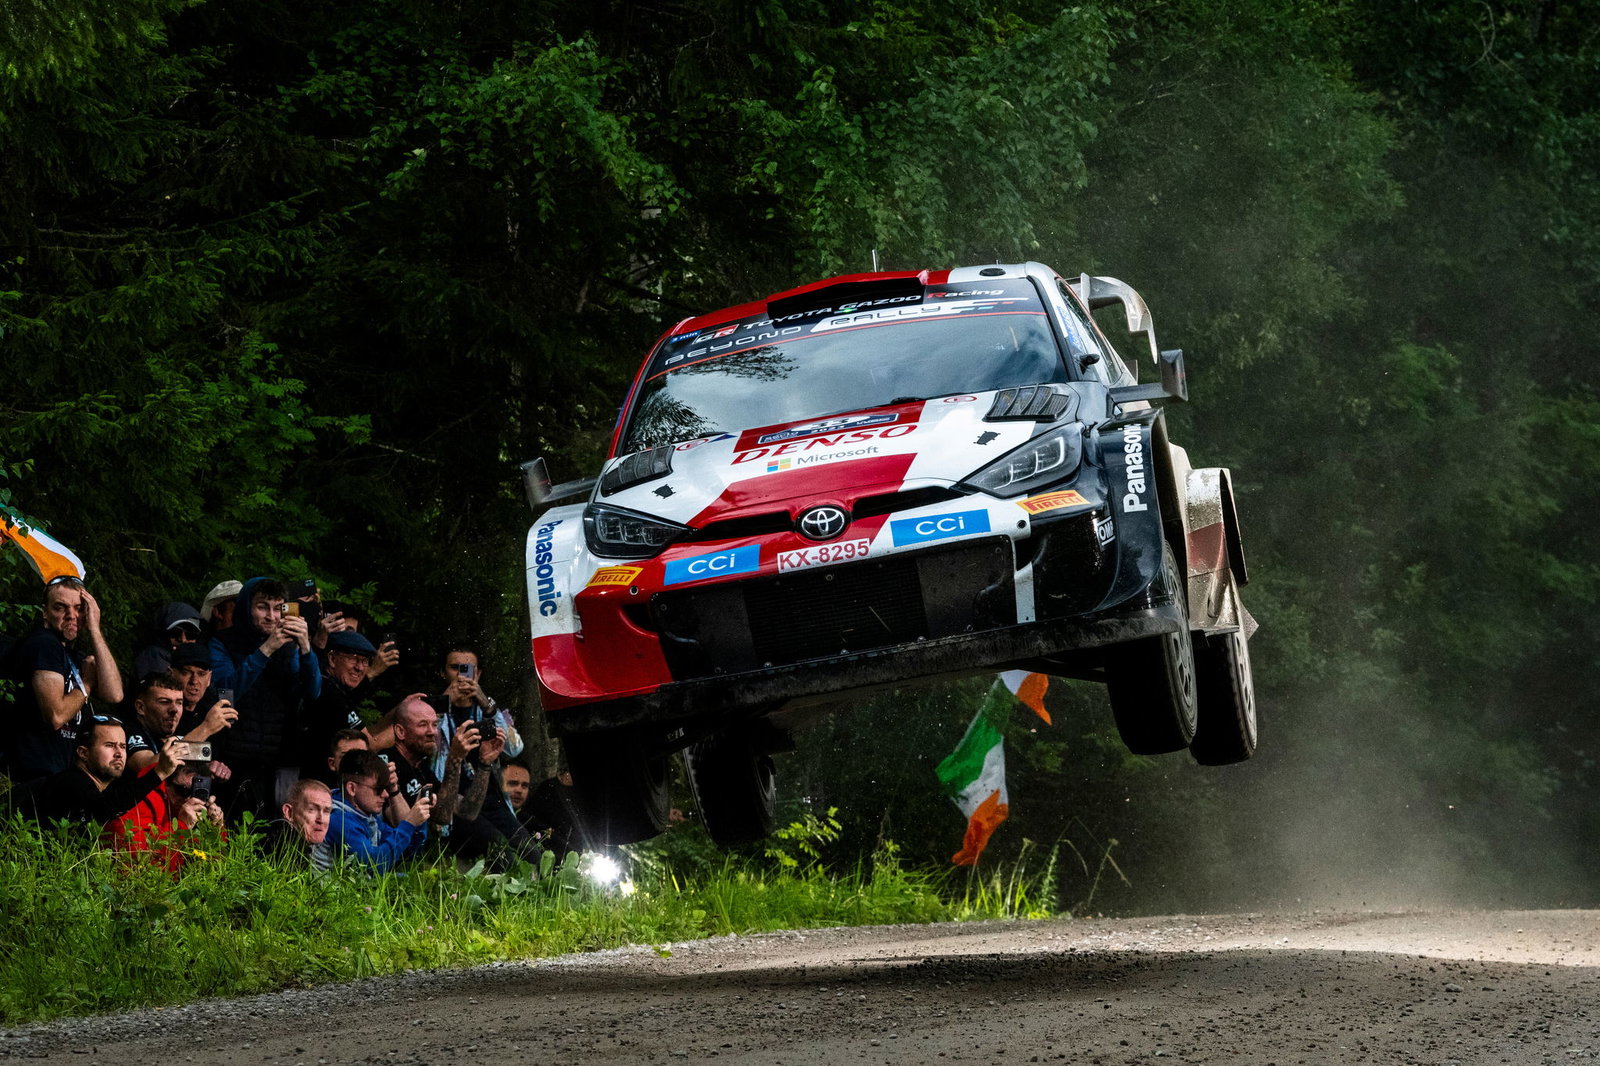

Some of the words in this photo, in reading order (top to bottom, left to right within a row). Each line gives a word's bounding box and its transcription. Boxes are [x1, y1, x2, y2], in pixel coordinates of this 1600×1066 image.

[743, 307, 832, 330] TOYOTA
[839, 294, 922, 310] GAZOO
[928, 289, 1005, 300] Racing
[665, 326, 801, 365] BEYOND
[830, 305, 941, 326] RALLY
[730, 424, 918, 466] DENSO
[797, 445, 879, 465] Microsoft
[1118, 423, 1148, 513] Panasoni
[1024, 492, 1084, 512] PIRELLI
[535, 519, 563, 617] Panasonic
[779, 540, 870, 570] KX-8295
[590, 569, 637, 585] PIRELLI
[406, 778, 422, 794] 42
